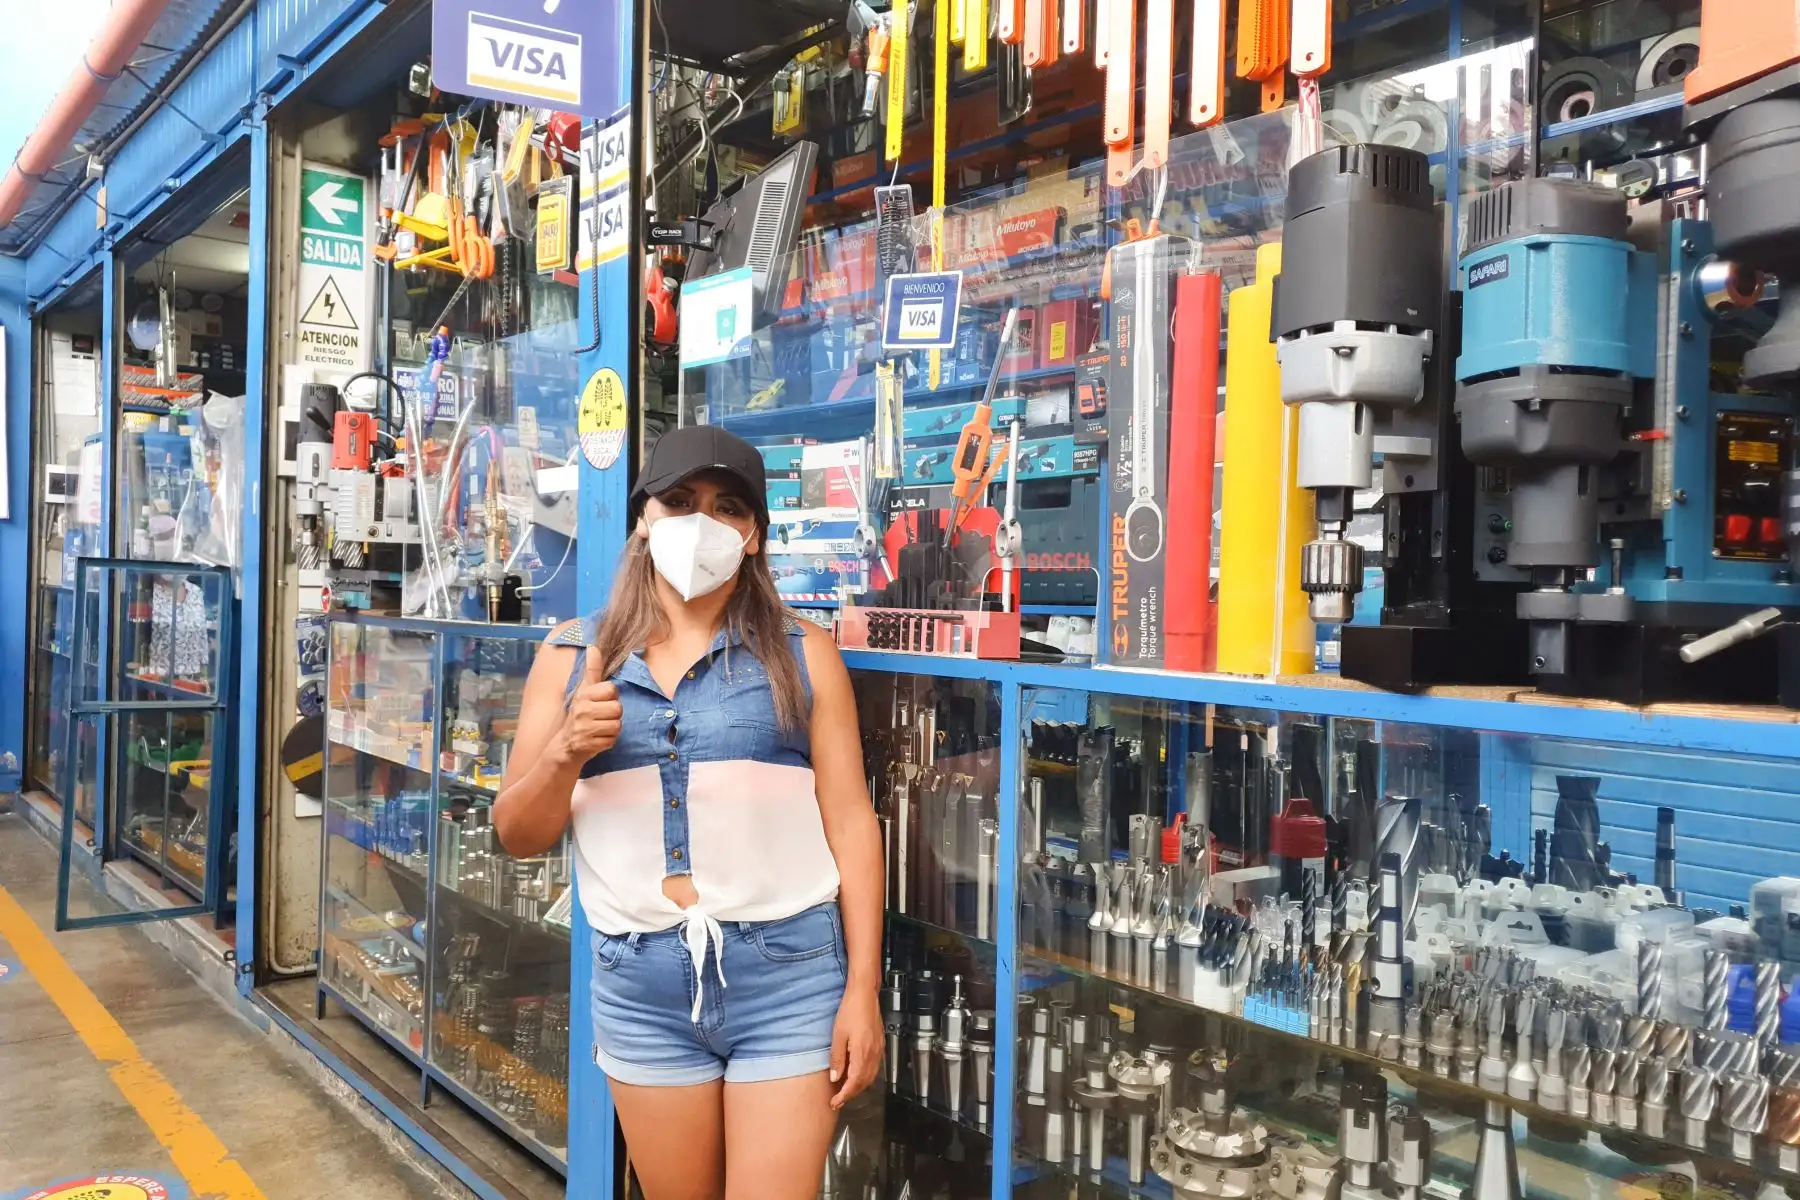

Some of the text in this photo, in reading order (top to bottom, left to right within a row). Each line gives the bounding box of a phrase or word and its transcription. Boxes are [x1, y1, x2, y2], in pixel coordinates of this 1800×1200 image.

[484, 37, 566, 80] VISA
[584, 131, 625, 174] VISA
[584, 204, 623, 243] VISA
[303, 236, 361, 267] SALIDA
[1470, 259, 1507, 284] SAFARI
[903, 282, 945, 295] BIENVENIDO
[908, 309, 936, 327] VISA
[313, 346, 346, 356] RIESGO
[829, 559, 860, 573] BOSCH
[1026, 552, 1091, 573] BOSCH
[1113, 516, 1129, 621] TRUPER
[1139, 597, 1148, 660] Torquímetro
[1148, 586, 1157, 660] Torque wrench
[94, 1175, 164, 1195] ESPERE
